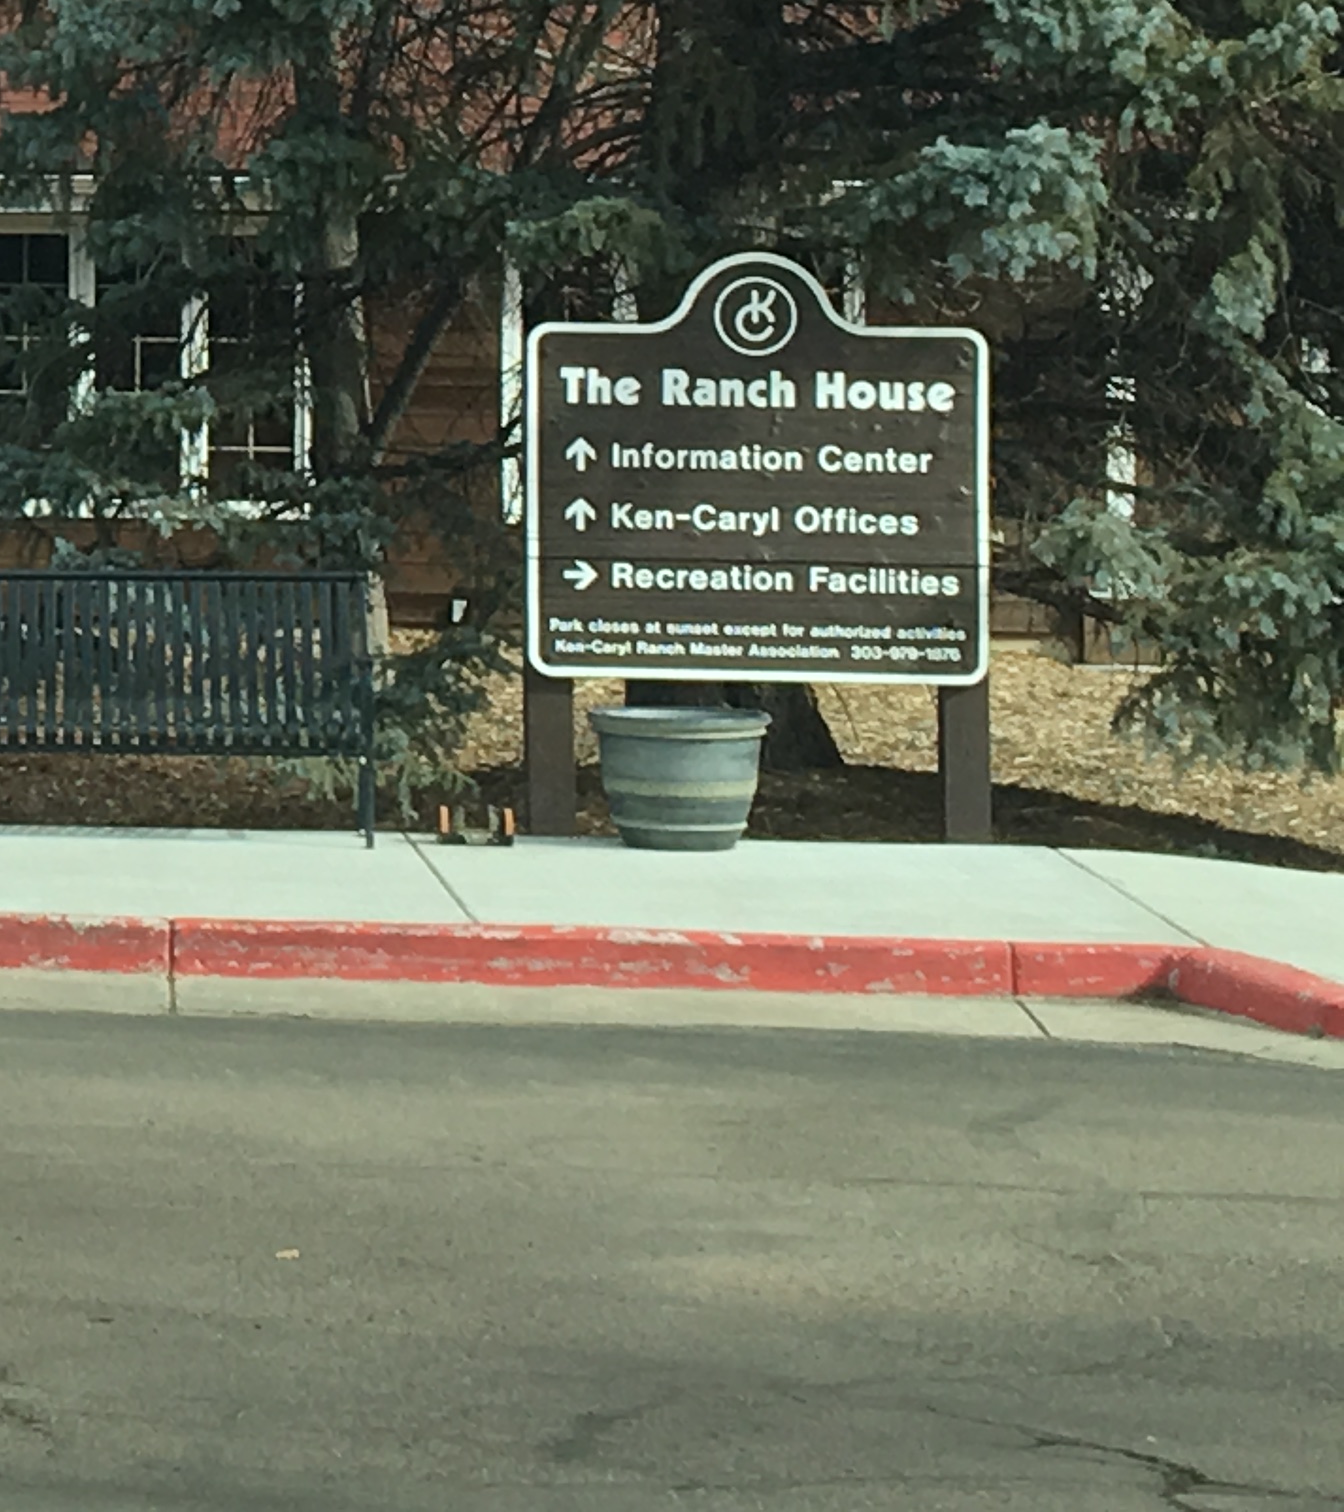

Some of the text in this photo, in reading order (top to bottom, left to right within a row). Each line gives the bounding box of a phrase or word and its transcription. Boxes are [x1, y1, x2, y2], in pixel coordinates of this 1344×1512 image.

[561, 367, 955, 411] The Ranch House
[613, 443, 932, 473] Information Center
[612, 503, 919, 536] Ken-Caryl Offices
[612, 562, 959, 596] Recreation Facilities
[549, 617, 585, 633] Park
[588, 618, 641, 635] closes
[644, 621, 662, 635] at
[666, 622, 720, 636] sunset
[722, 623, 778, 638] except
[781, 623, 805, 638] for
[809, 624, 892, 640] authorized
[554, 638, 633, 657] Ken-Caryl
[635, 640, 686, 657] Ranch
[689, 641, 744, 657] Master
[747, 643, 841, 659] Association
